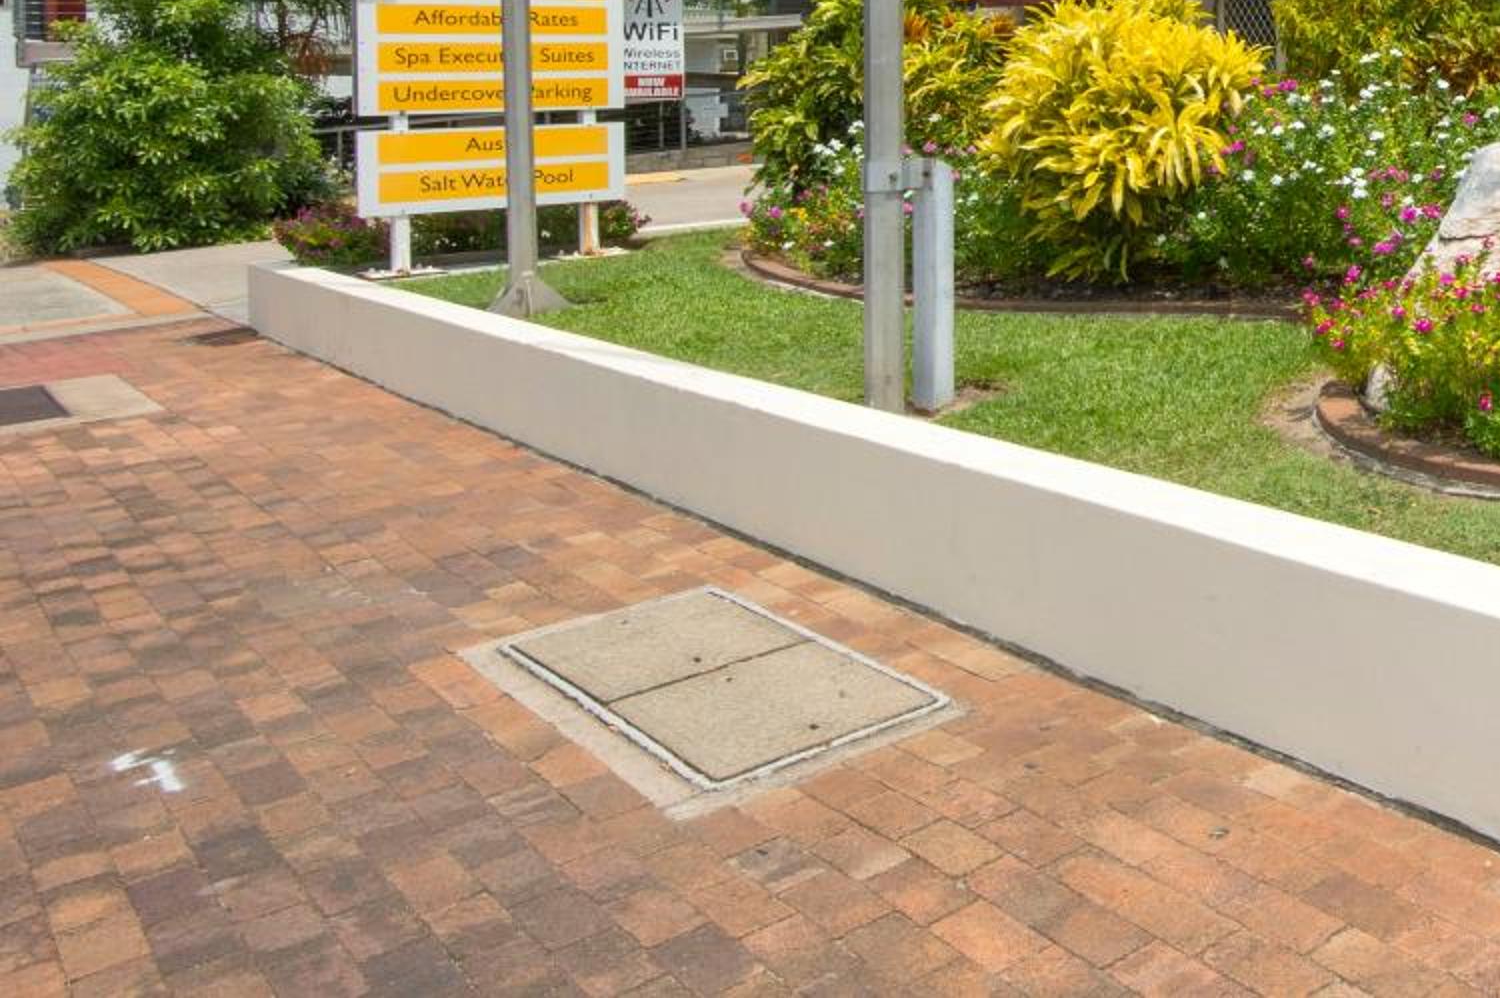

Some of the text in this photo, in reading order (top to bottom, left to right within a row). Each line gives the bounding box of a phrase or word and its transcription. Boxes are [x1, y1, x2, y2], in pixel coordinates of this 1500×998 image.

[414, 10, 579, 27] Affordab Rates
[623, 22, 679, 41] WiFi
[394, 47, 431, 68] Spa
[540, 47, 594, 63] Suites
[624, 61, 680, 71] NTERNET
[393, 85, 505, 103] Undercove
[420, 174, 456, 194] Salt
[461, 172, 508, 189] Wat
